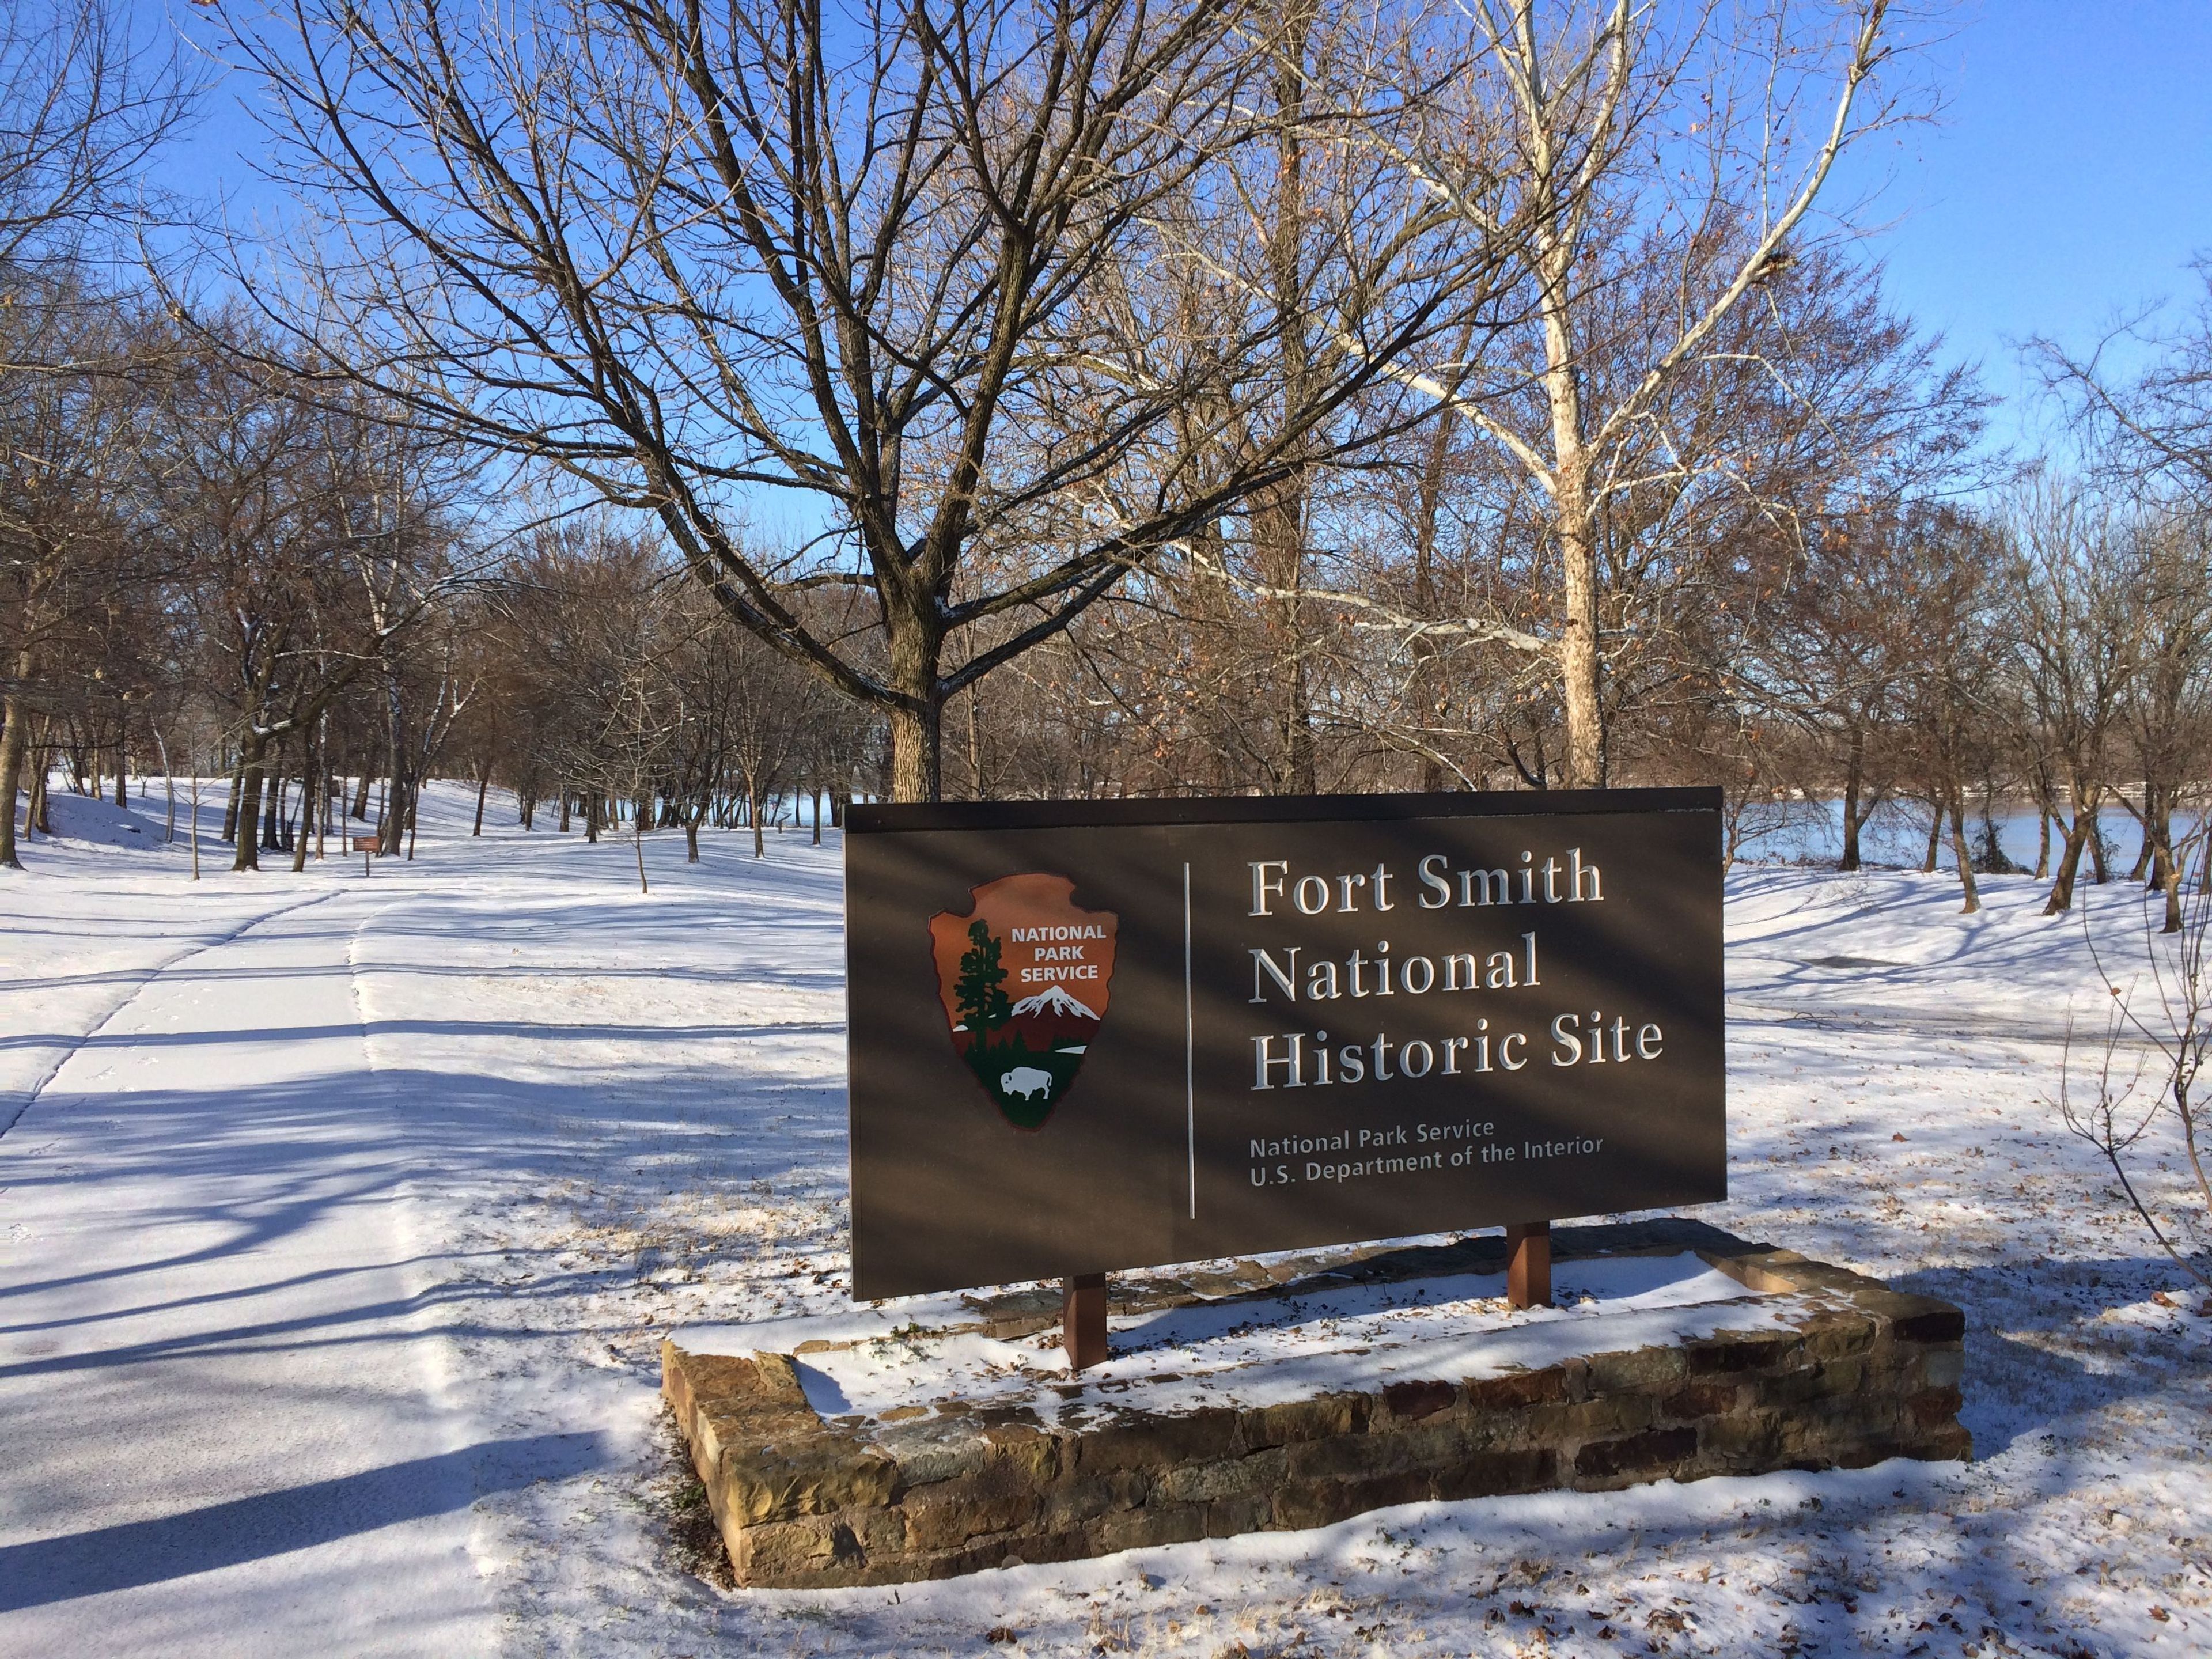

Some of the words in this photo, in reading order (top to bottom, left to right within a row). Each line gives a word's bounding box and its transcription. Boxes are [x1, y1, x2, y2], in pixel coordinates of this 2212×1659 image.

[1248, 859, 1395, 916] Fort
[1419, 847, 1604, 909] Smith
[1011, 925, 1107, 942] NATIONAL
[1034, 945, 1085, 961] PARK
[1020, 965, 1099, 982] SERVICE
[1248, 931, 1540, 1004] National
[1250, 1018, 1528, 1090] Historic
[1551, 1010, 1664, 1067] Site
[1250, 1130, 1349, 1158] National
[1359, 1126, 1407, 1148] Park
[1416, 1119, 1495, 1142] Service
[1251, 1165, 1296, 1187] U.S.
[1306, 1150, 1442, 1183] Department
[1450, 1146, 1473, 1166] of
[1481, 1143, 1516, 1162] the
[1524, 1136, 1604, 1159] Interior
